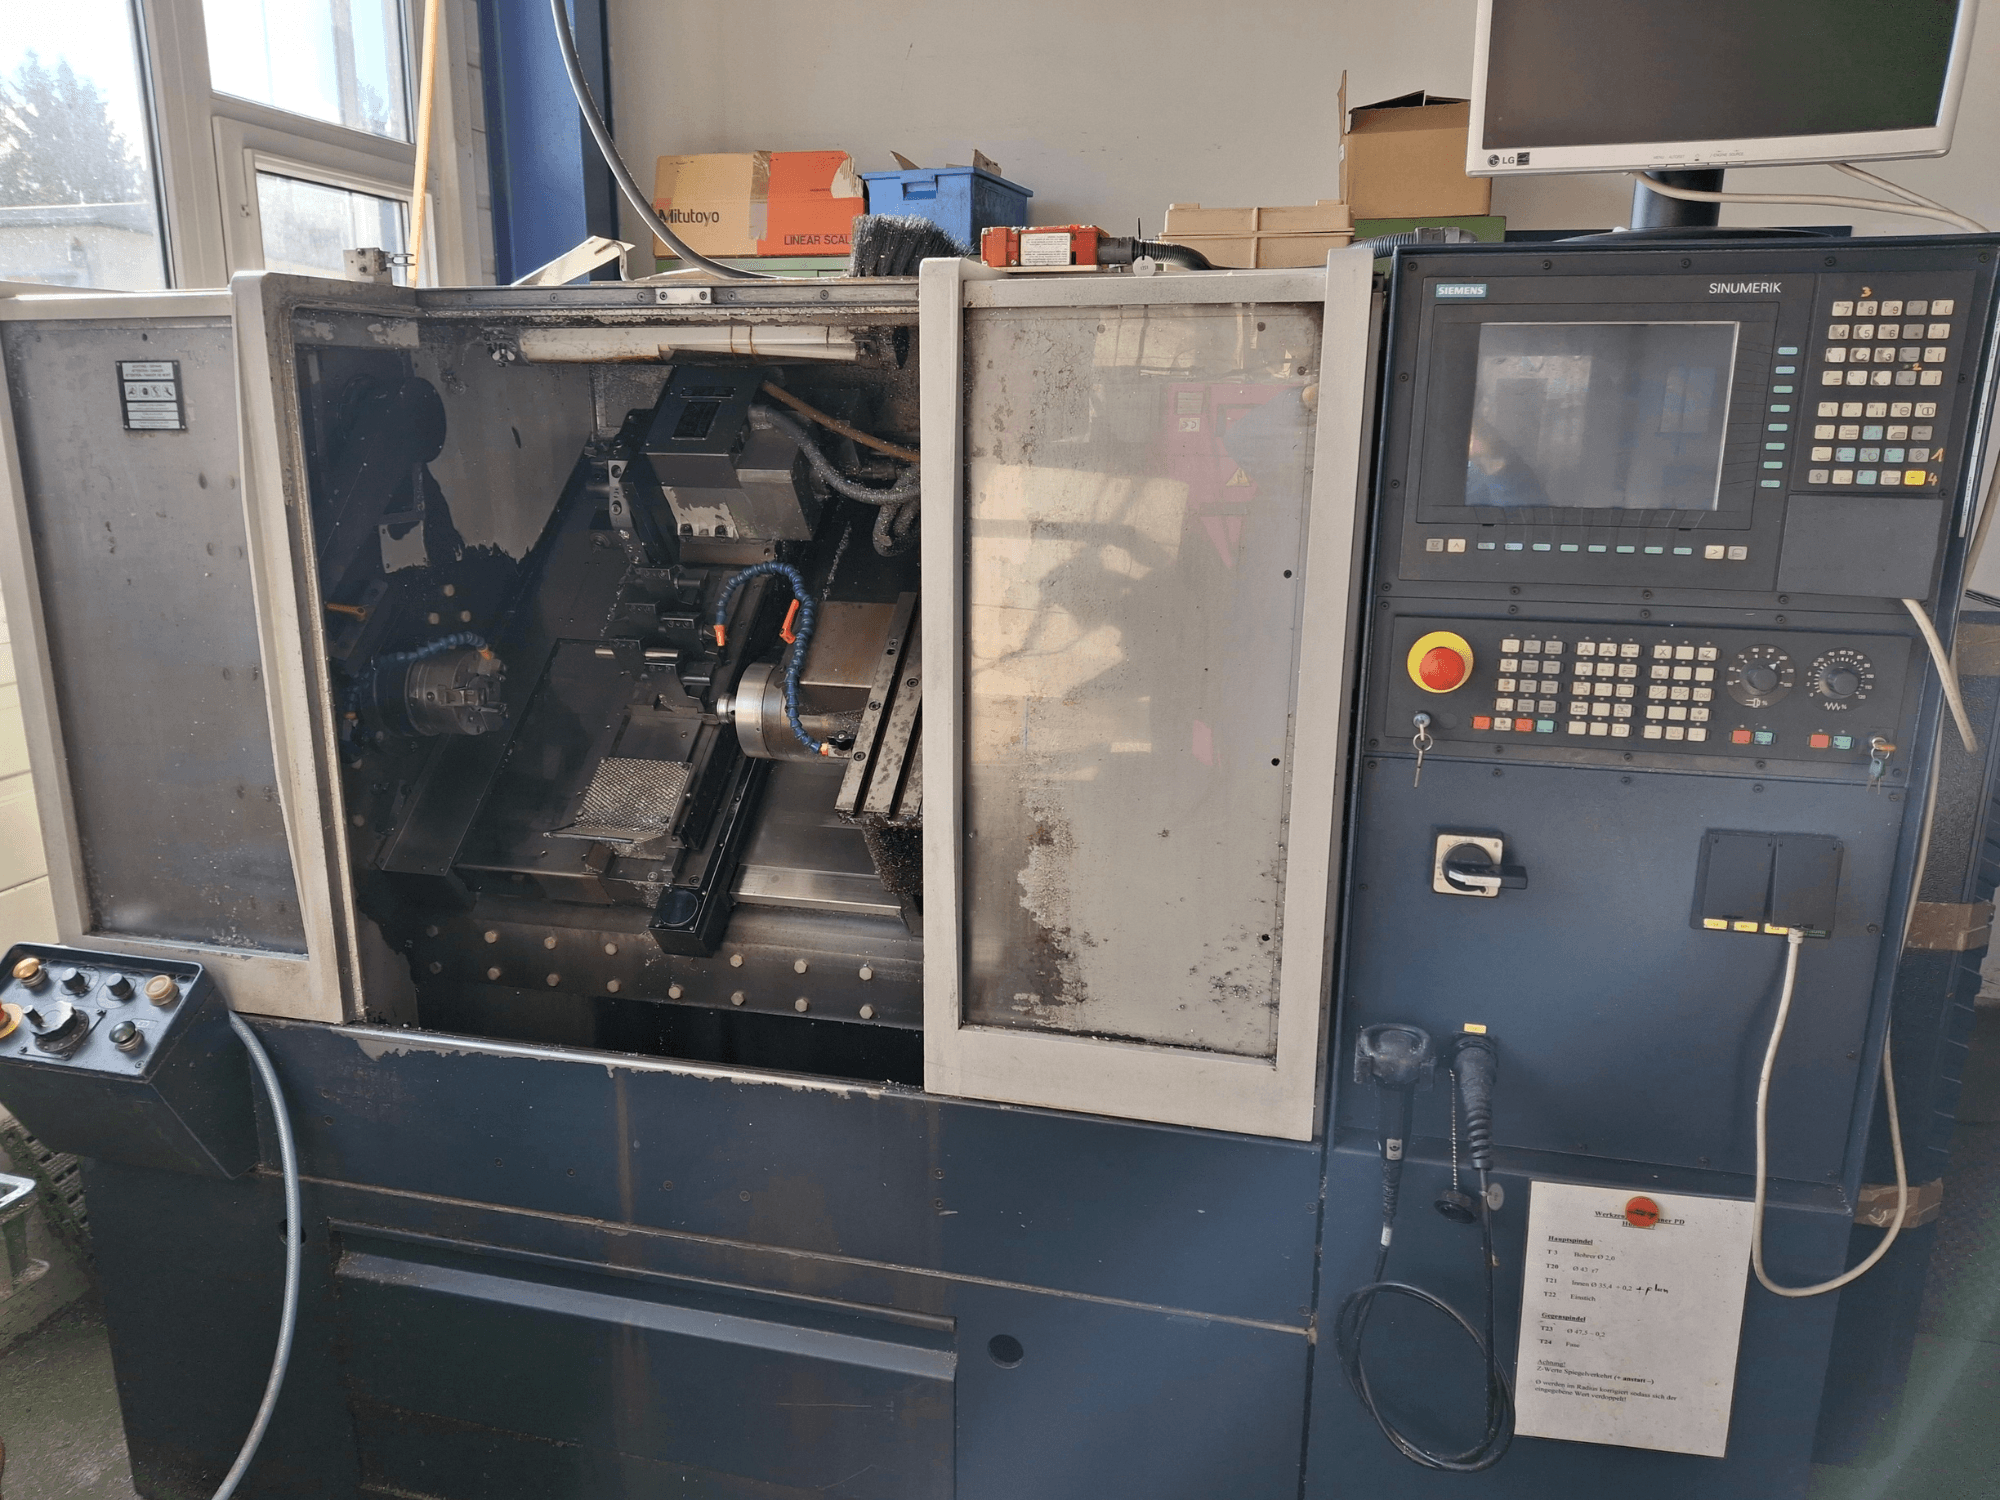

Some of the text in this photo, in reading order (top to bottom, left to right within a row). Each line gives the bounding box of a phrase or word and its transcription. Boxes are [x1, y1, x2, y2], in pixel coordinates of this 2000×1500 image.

[1502, 156, 1515, 164] LG
[659, 208, 720, 227] Mitutoyo
[784, 234, 853, 246] LINEAR SCAL
[1438, 286, 1485, 295] SIEMENS
[1708, 282, 1782, 294] SINUMERIK
[1860, 286, 1872, 298] 3
[1843, 306, 1850, 315] 7
[1867, 306, 1874, 315] 8
[1892, 306, 1899, 315] 9
[1839, 329, 1845, 338] 4
[1864, 329, 1870, 338] 5
[1889, 329, 1896, 338] 6
[1885, 353, 1892, 361] 3
[1927, 472, 1938, 487] 4
[1659, 648, 1667, 657] X
[1695, 690, 1711, 699] Tool
[1548, 1235, 1593, 1246] Hauptspindel
[1541, 1312, 1586, 1323] Gegenspindel
